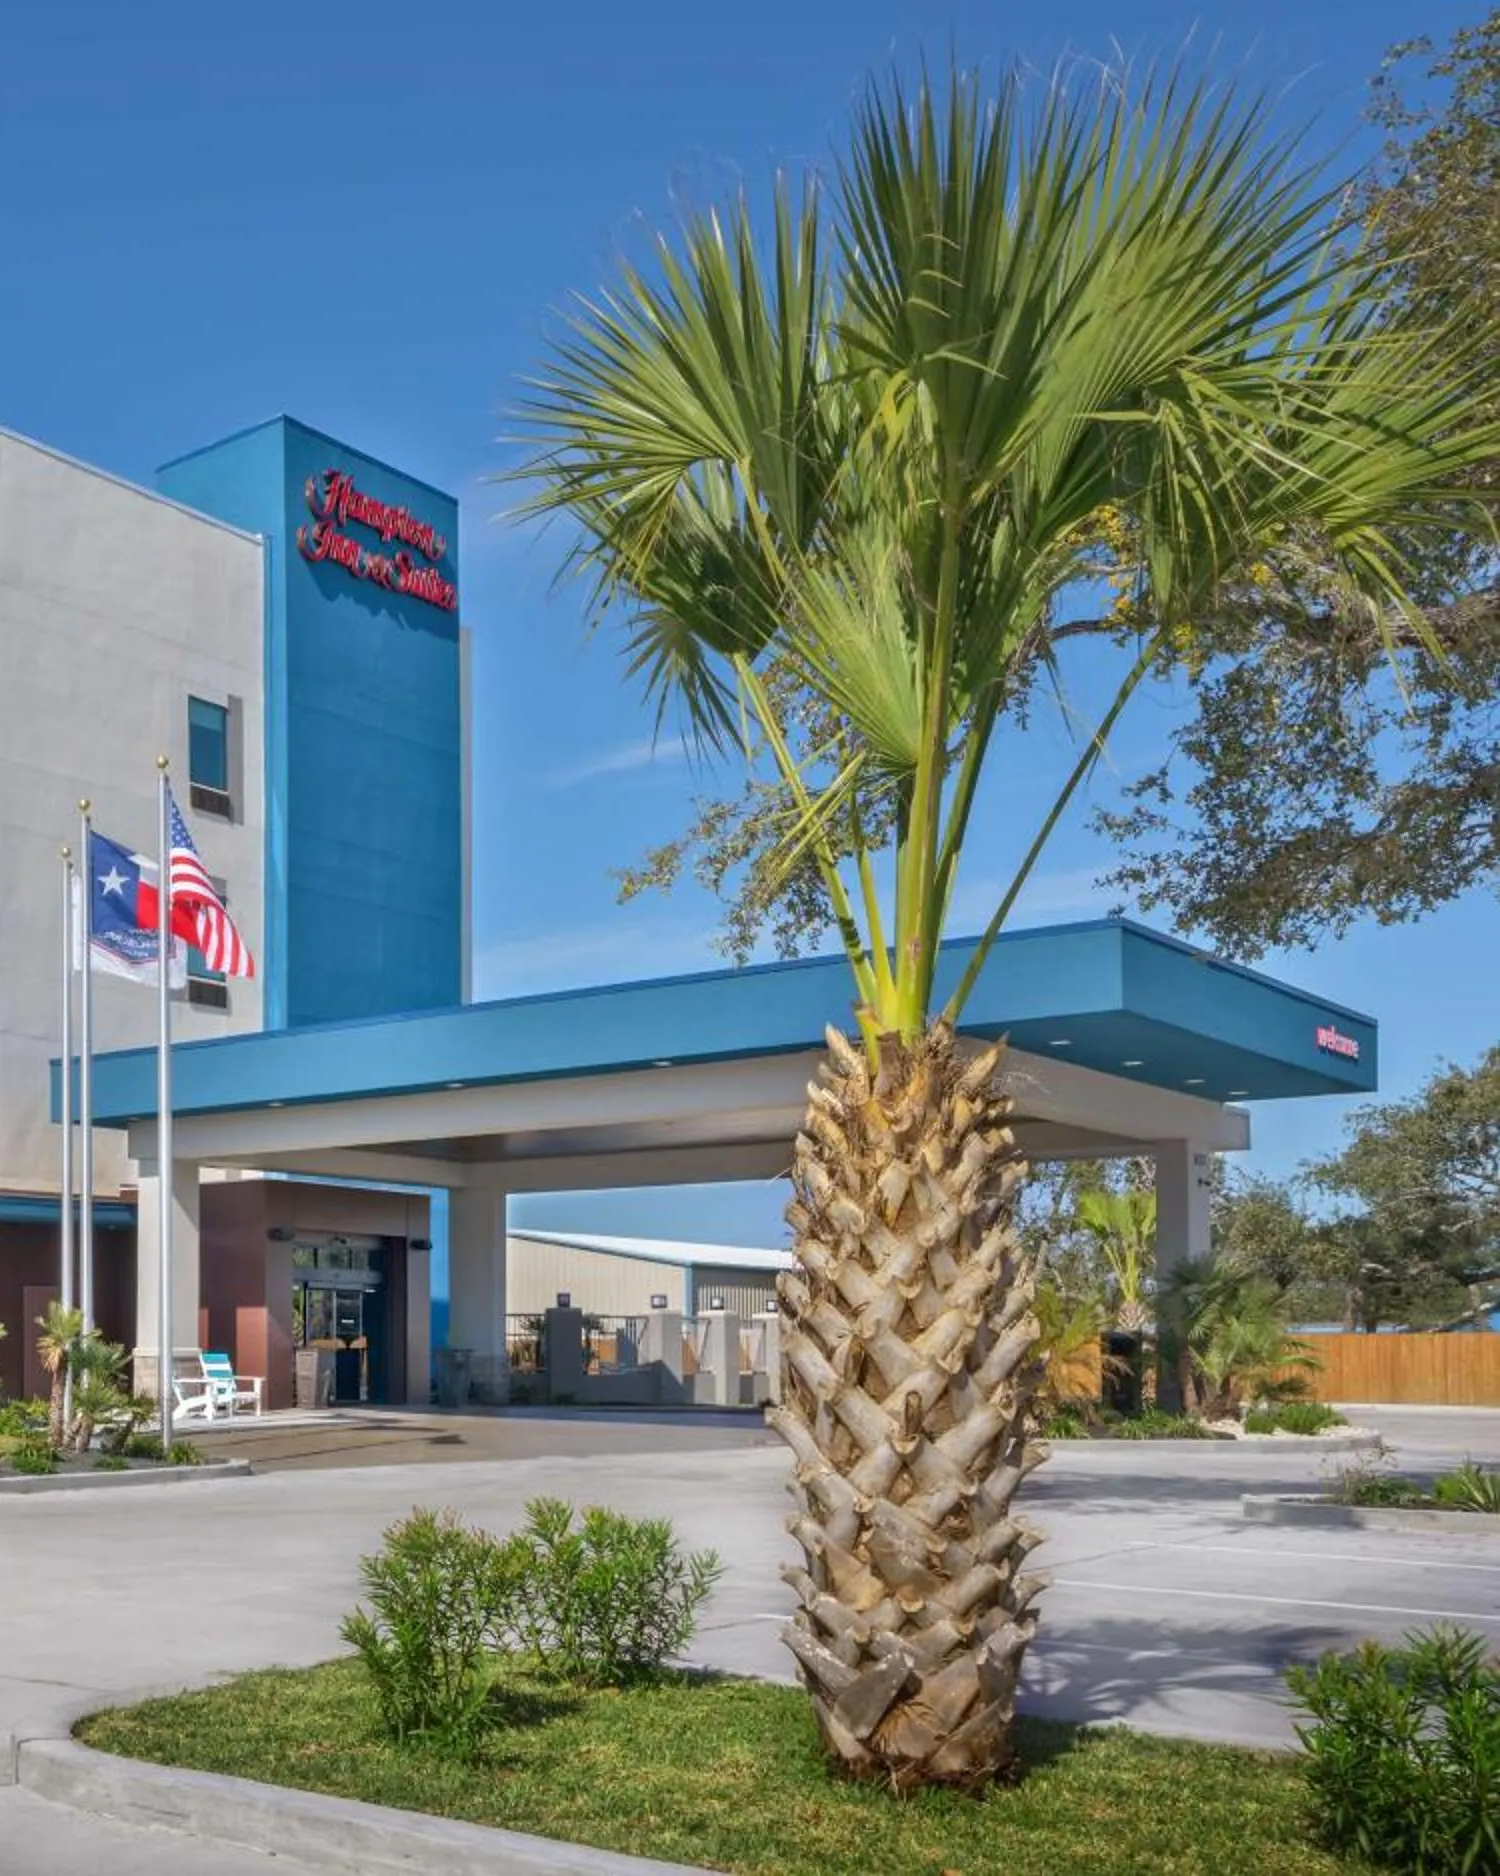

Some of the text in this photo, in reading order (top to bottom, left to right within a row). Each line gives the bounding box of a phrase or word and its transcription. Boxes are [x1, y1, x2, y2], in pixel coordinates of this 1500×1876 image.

[305, 466, 447, 562] Hampton
[296, 519, 367, 578] Inn
[389, 550, 457, 612] Suites
